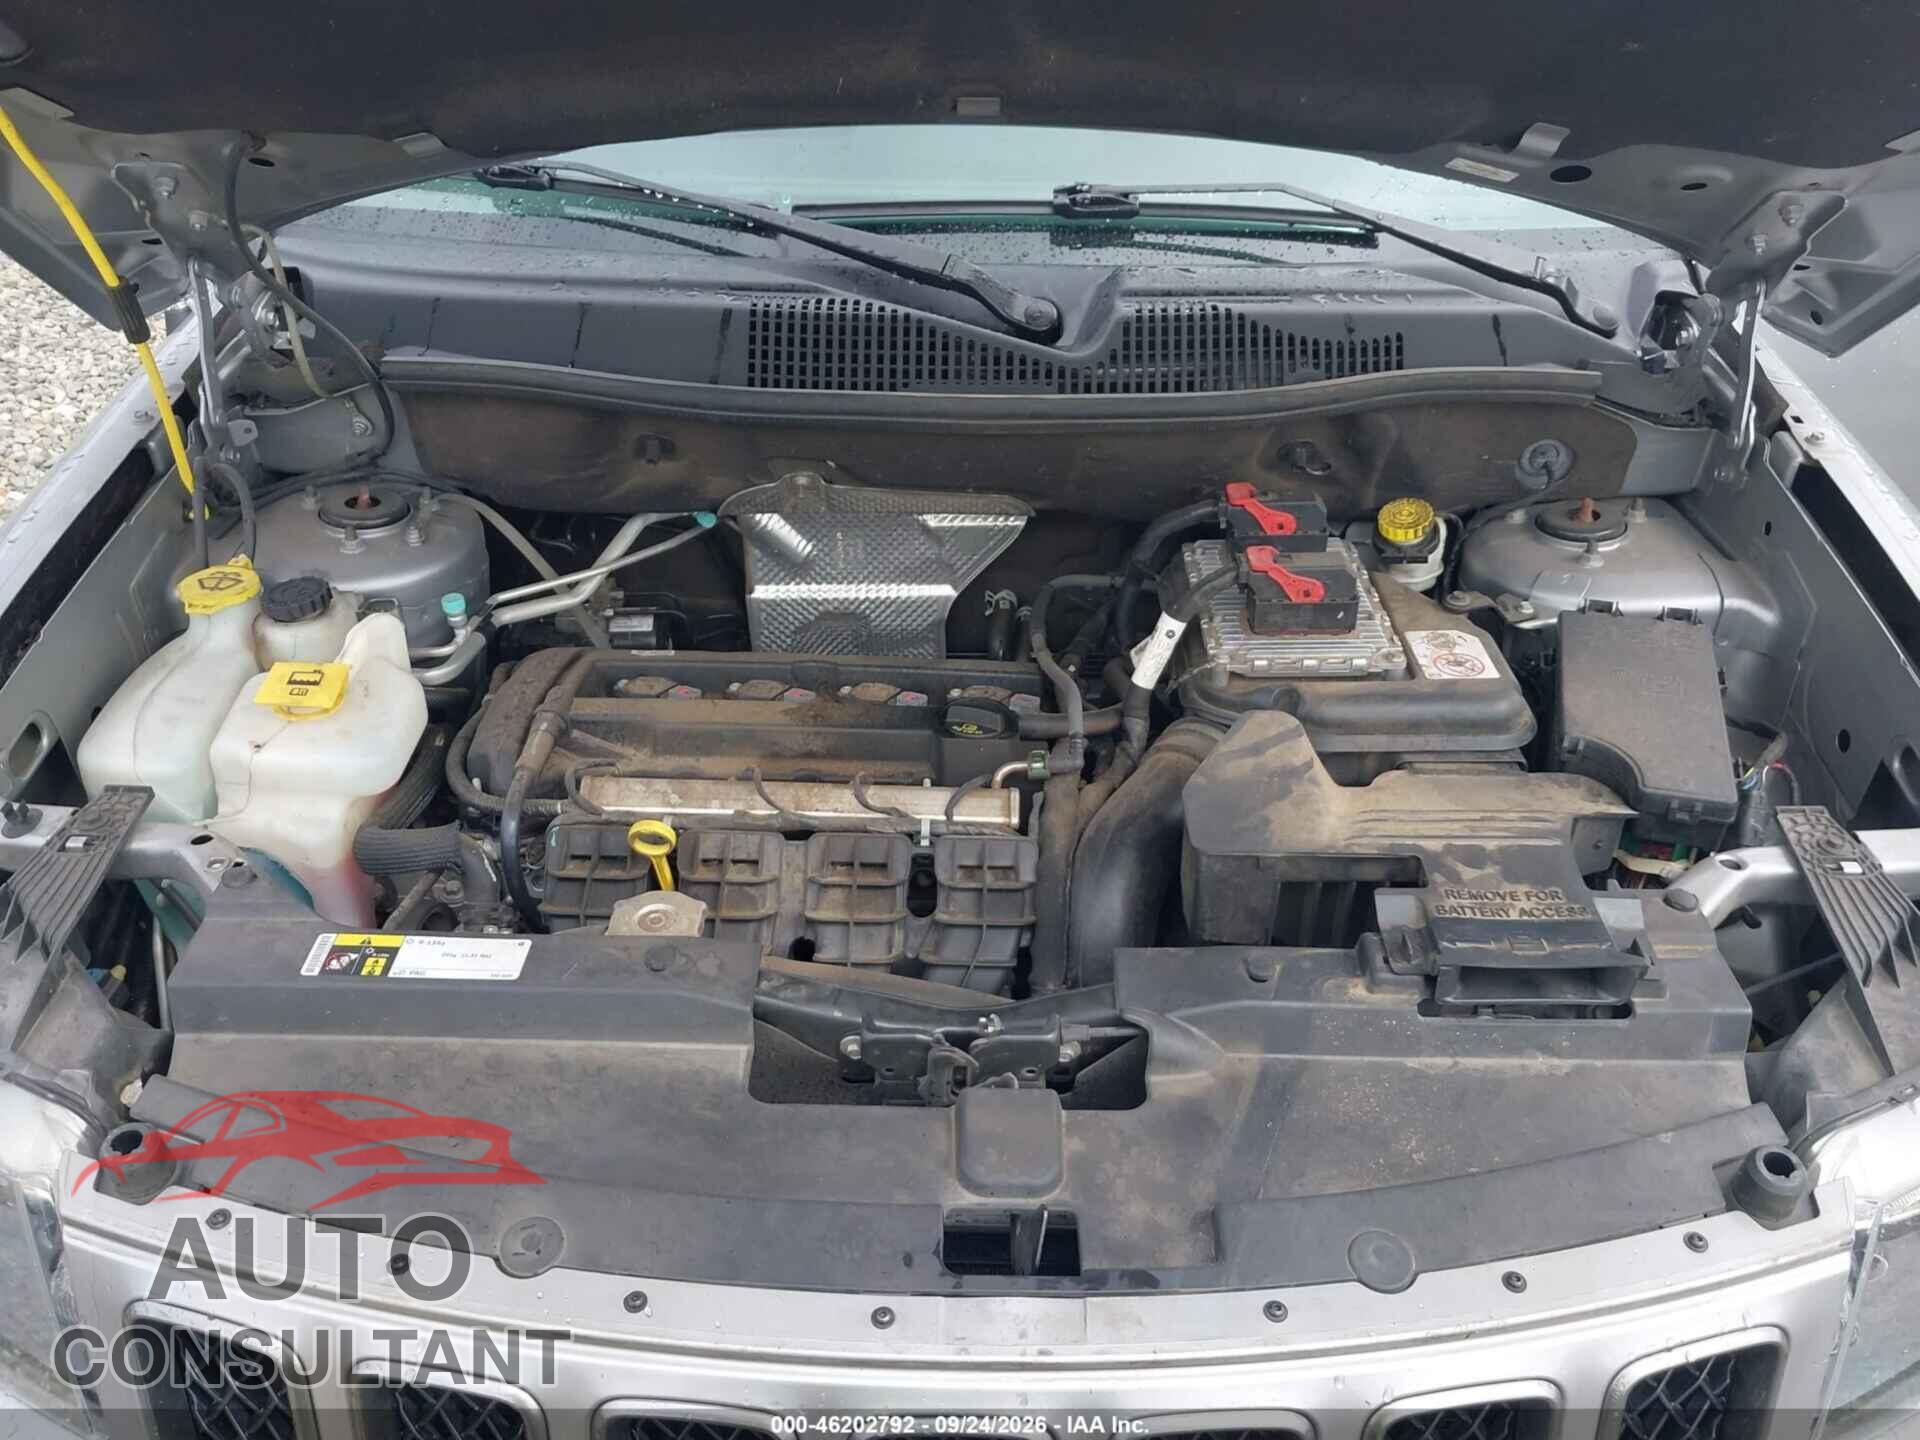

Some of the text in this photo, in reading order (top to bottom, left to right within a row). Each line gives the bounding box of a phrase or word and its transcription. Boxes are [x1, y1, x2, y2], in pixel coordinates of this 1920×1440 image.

[1444, 888, 1564, 902] REMOVE FOR
[1435, 904, 1512, 918] BATTERY
